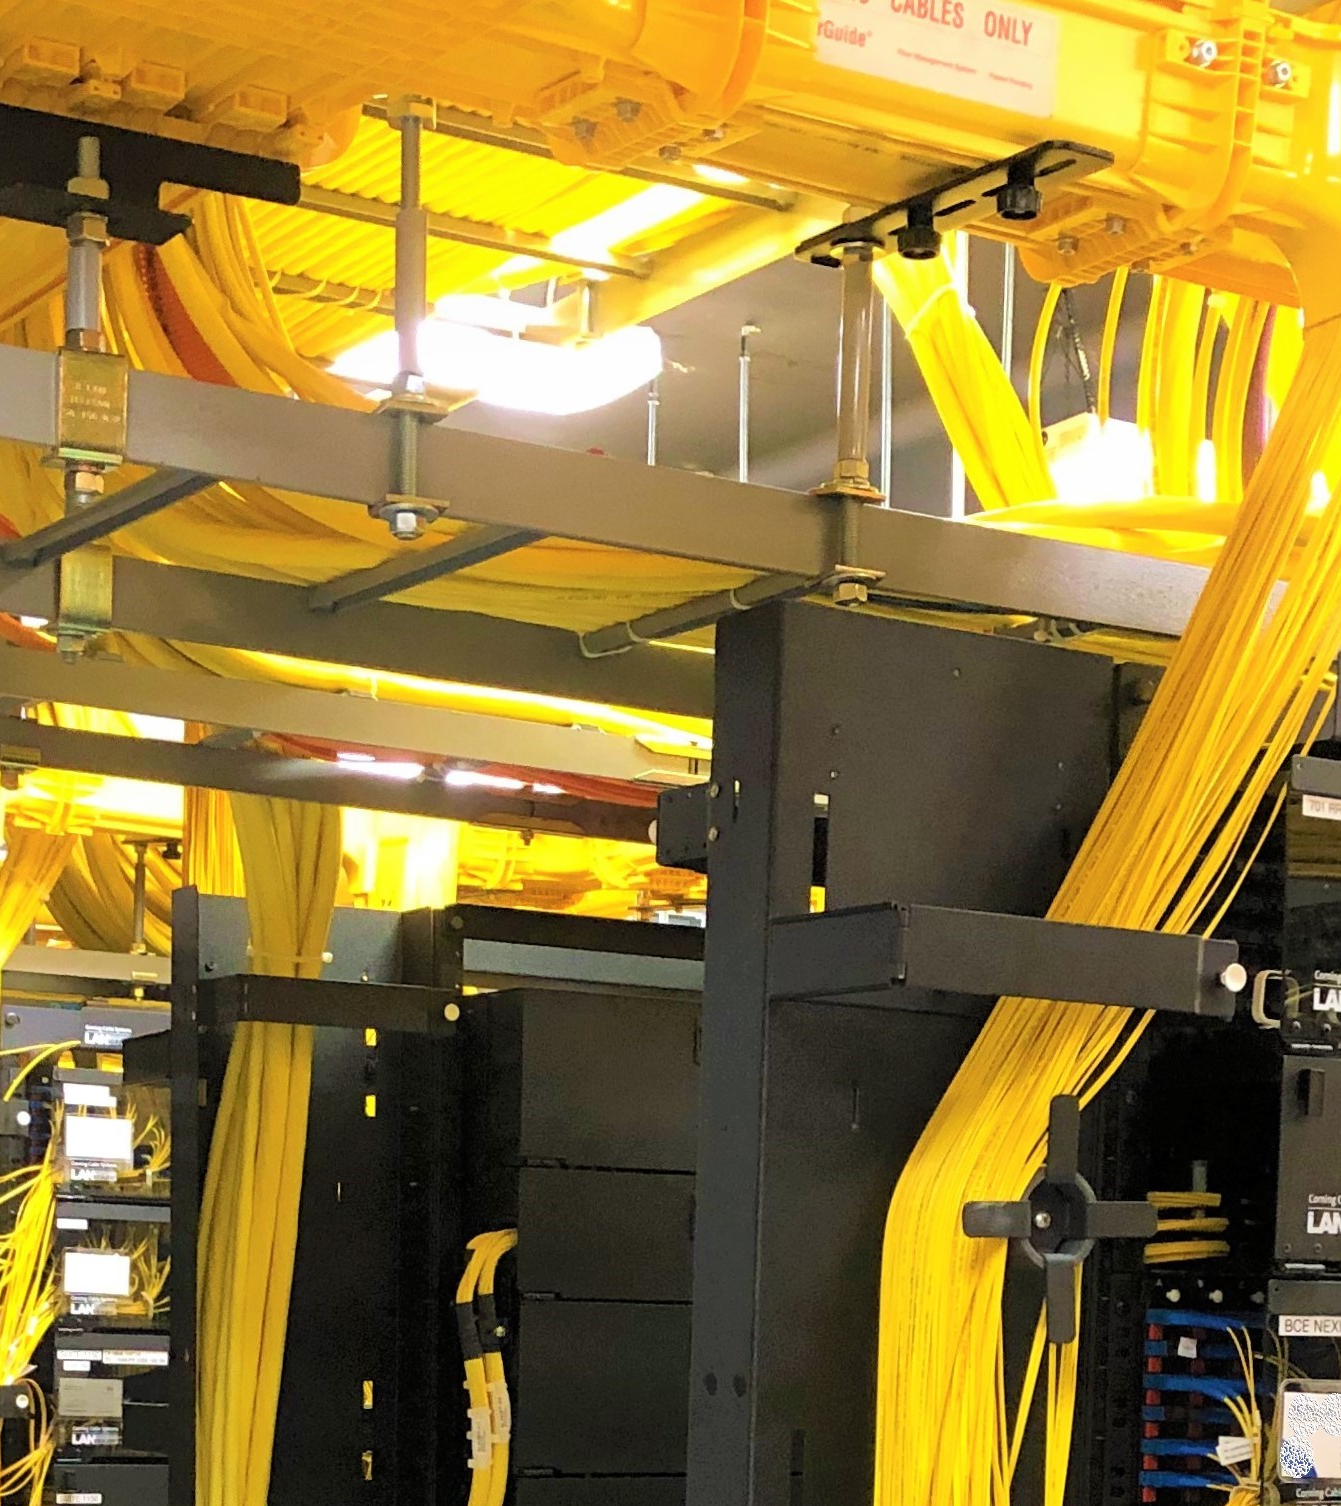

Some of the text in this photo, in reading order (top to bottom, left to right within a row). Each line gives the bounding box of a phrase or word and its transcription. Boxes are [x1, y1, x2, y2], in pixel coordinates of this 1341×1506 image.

[984, 11, 1033, 46] ONLY
[1308, 1193, 1337, 1207] Corning
[1284, 1318, 1310, 1332] BCE
[1296, 1487, 1324, 1500] Corning
